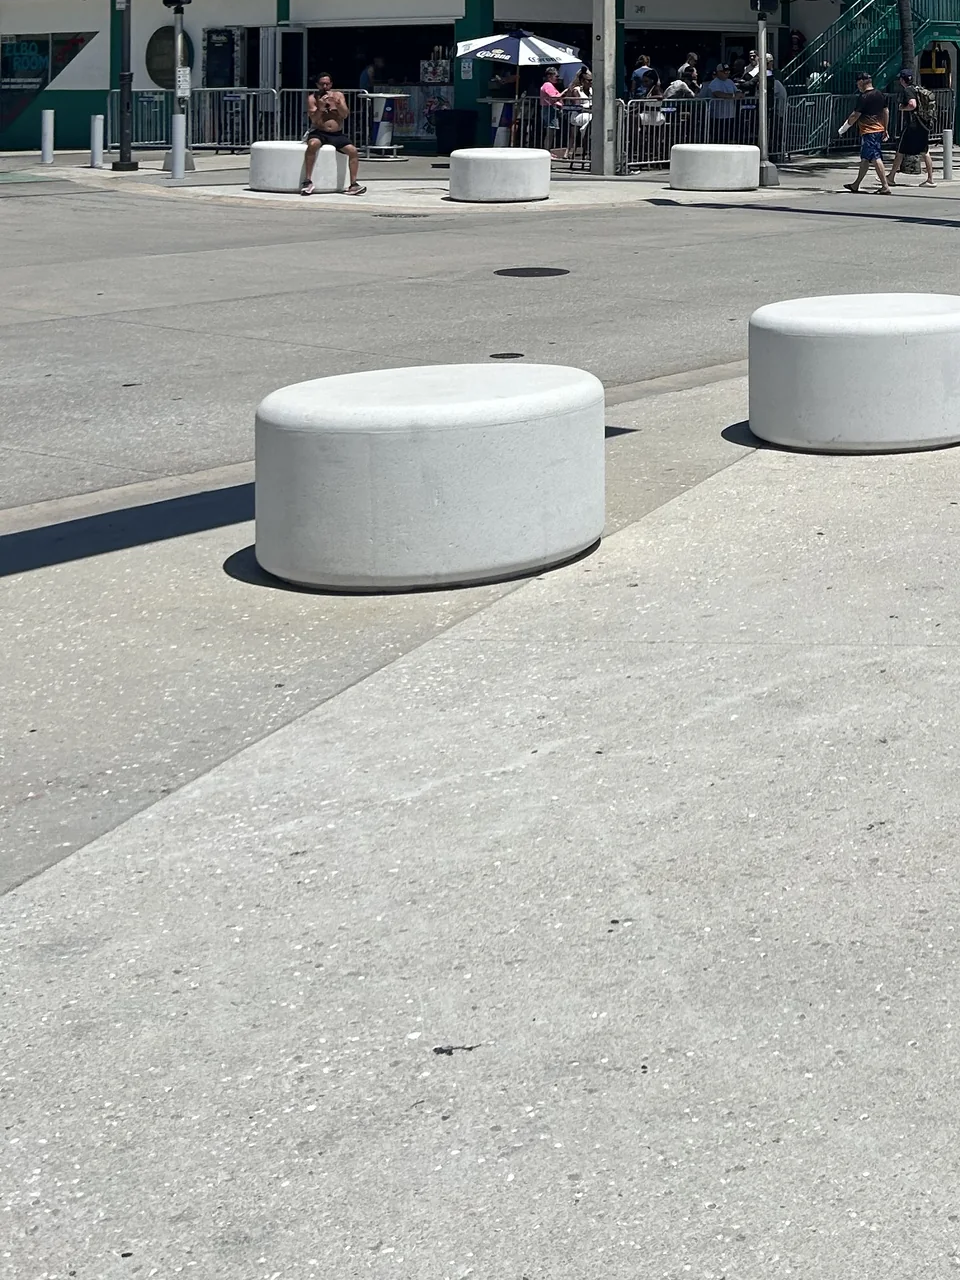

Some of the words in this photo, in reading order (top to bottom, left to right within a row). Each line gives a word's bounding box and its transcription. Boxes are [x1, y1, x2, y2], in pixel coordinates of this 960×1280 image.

[5, 42, 39, 56] ELBO
[475, 50, 512, 61] Corona
[13, 55, 48, 70] ROOM
